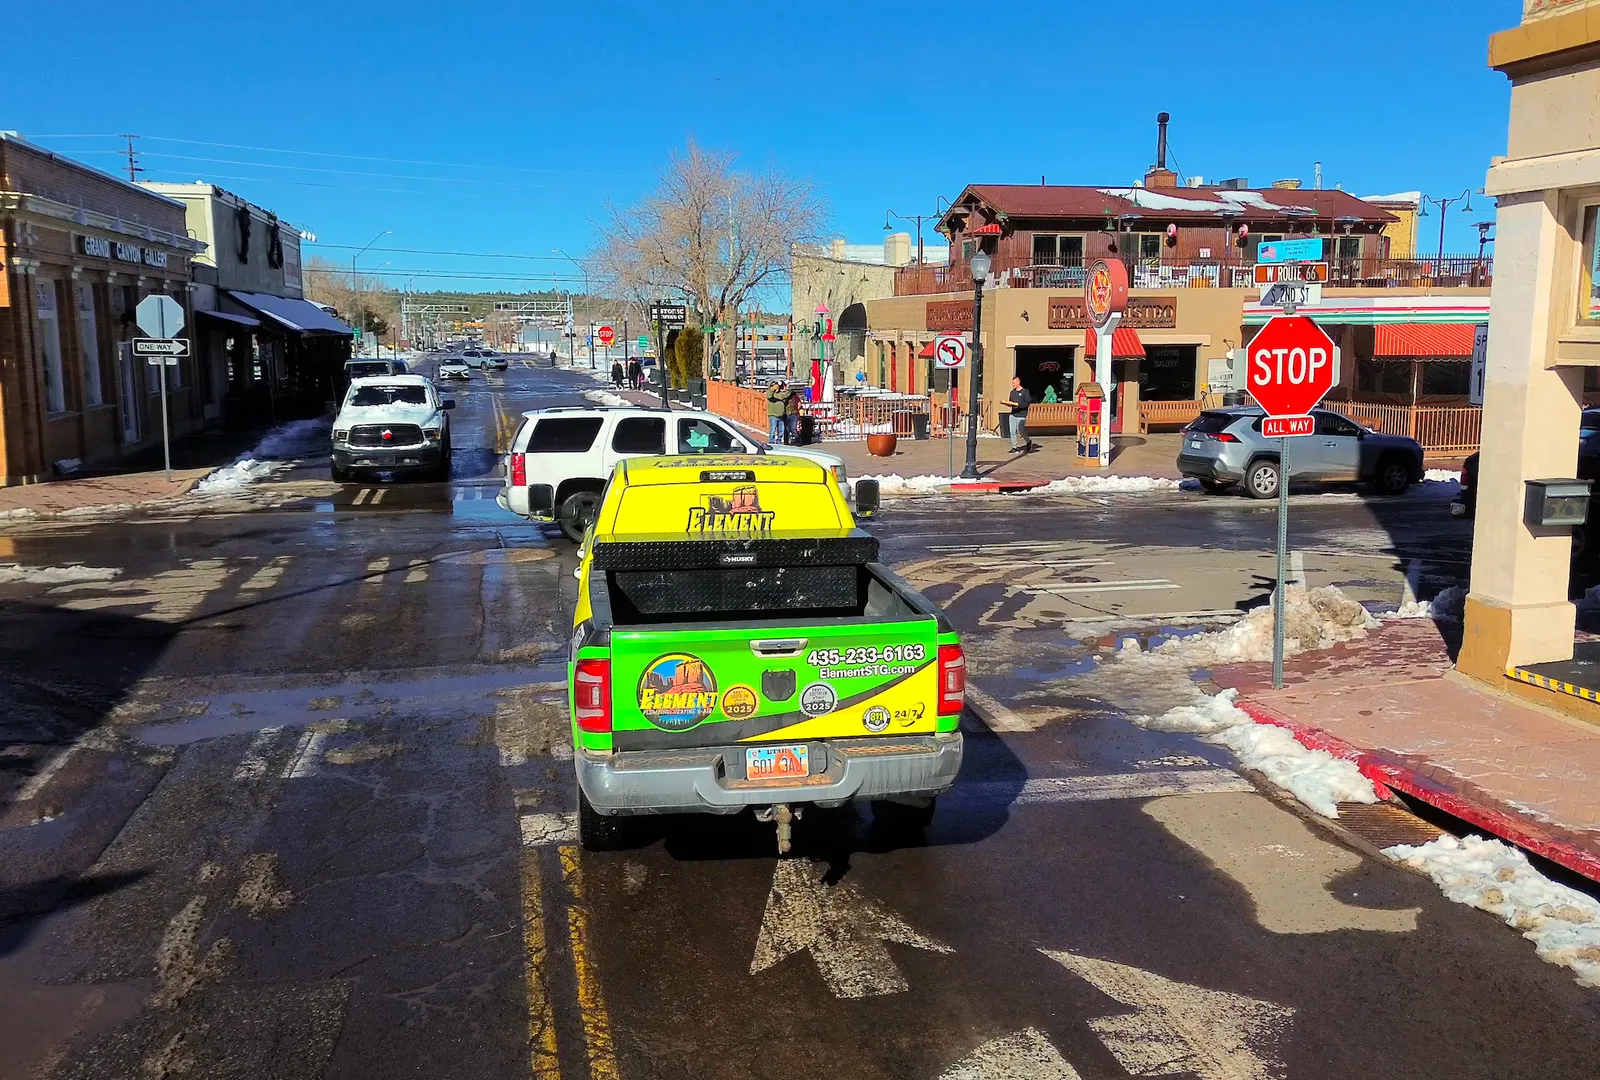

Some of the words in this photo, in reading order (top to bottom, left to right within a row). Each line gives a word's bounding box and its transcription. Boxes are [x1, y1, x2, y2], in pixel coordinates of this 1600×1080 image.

[85, 236, 109, 258] GRAND
[117, 242, 141, 263] CANYON
[144, 248, 167, 267] GALLERY
[1267, 267, 1275, 282] W
[1278, 266, 1301, 281] ROUTE
[1306, 265, 1316, 280] 66
[1271, 288, 1276, 302] S
[1280, 288, 1295, 302] 2ND
[1300, 287, 1310, 302] ST
[1123, 304, 1173, 318] ISTRO
[599, 330, 613, 338] STOP
[1254, 347, 1327, 386] STOP
[1267, 422, 1285, 433] ALL
[1290, 420, 1310, 432] WAY
[686, 507, 775, 533] ELEMENT
[807, 644, 925, 666] 435-233-6163
[819, 665, 915, 679] ElementSTG.com
[640, 688, 718, 709] ELEMENT
[727, 705, 753, 713] 2025
[806, 702, 831, 711] 2025
[894, 708, 918, 718] 24/7
[870, 712, 883, 721] 811
